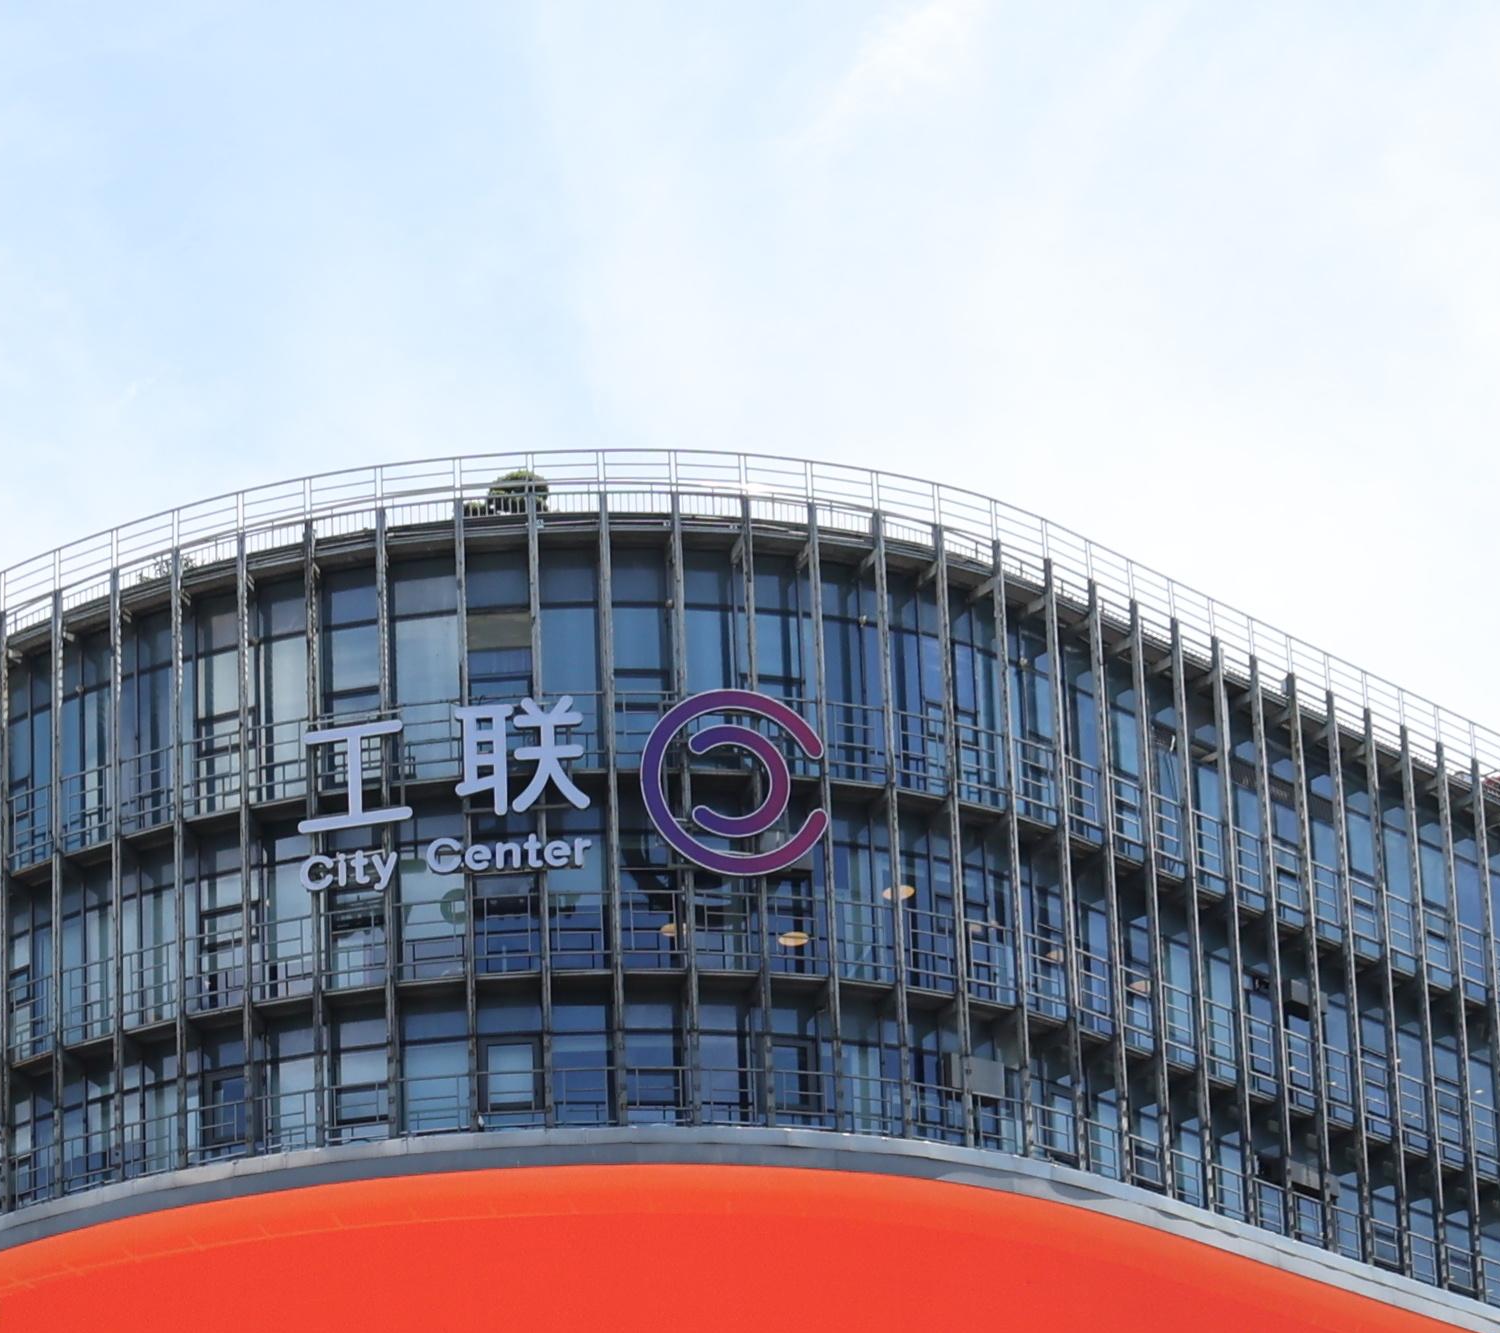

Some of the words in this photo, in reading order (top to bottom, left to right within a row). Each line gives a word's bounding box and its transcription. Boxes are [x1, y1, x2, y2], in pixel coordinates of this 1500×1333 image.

[298, 695, 590, 834] 工联
[299, 848, 397, 892] City
[425, 832, 591, 876] Center
